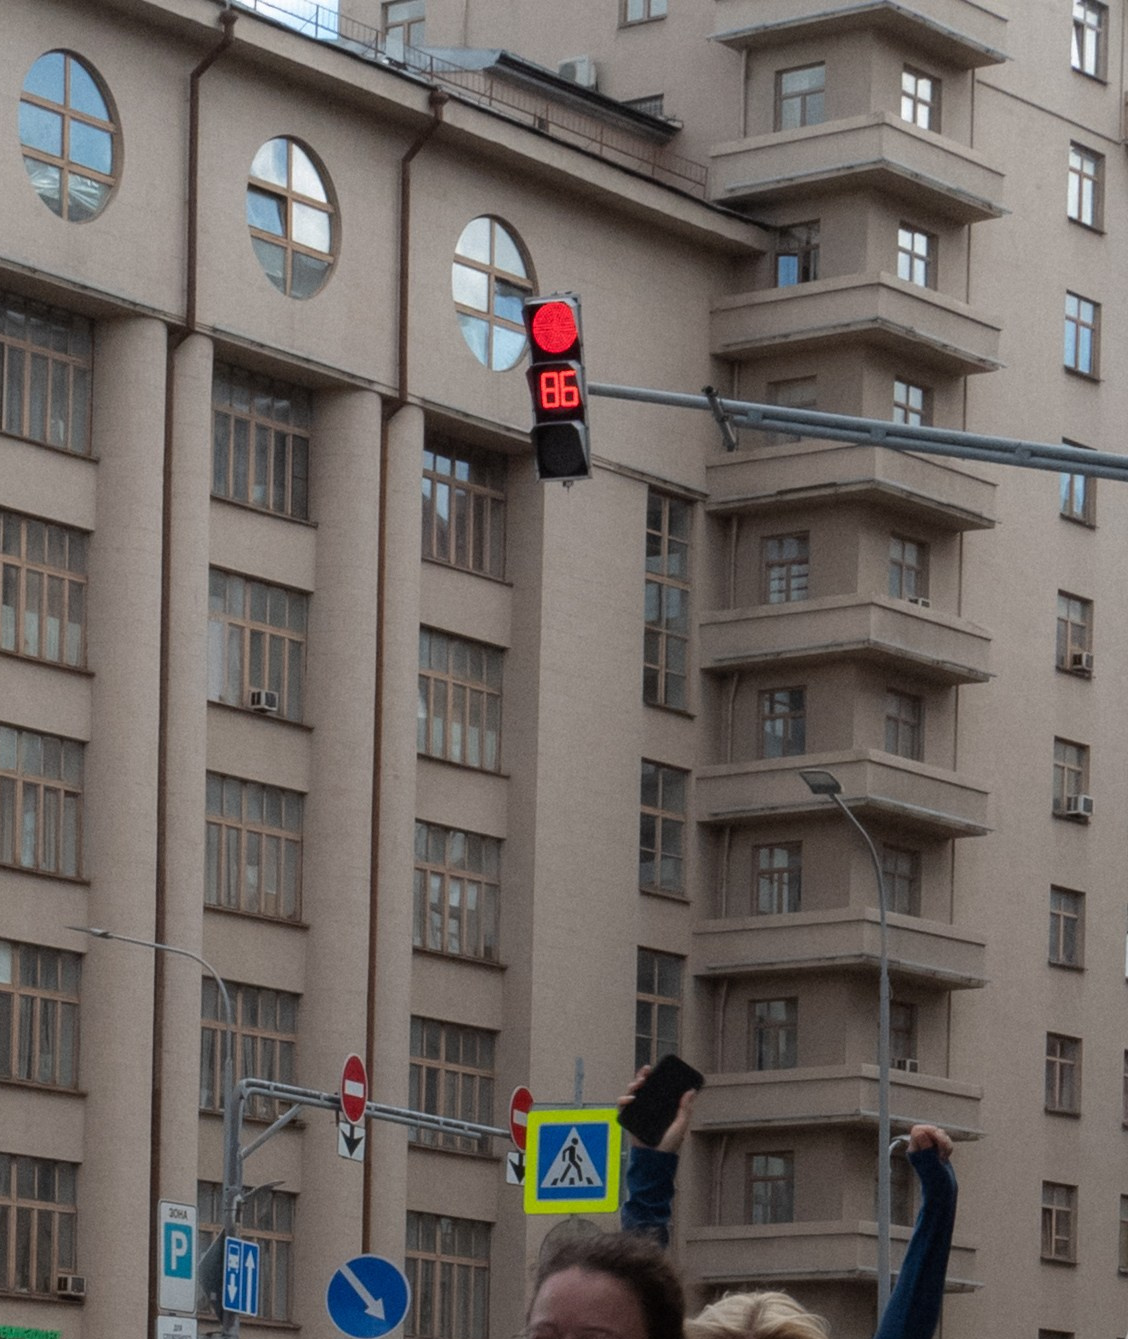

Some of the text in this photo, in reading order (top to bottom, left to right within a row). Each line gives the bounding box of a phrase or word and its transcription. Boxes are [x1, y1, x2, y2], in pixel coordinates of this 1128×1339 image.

[539, 369, 580, 409] 86
[169, 1208, 188, 1221] ЗОНА
[171, 1230, 188, 1270] P
